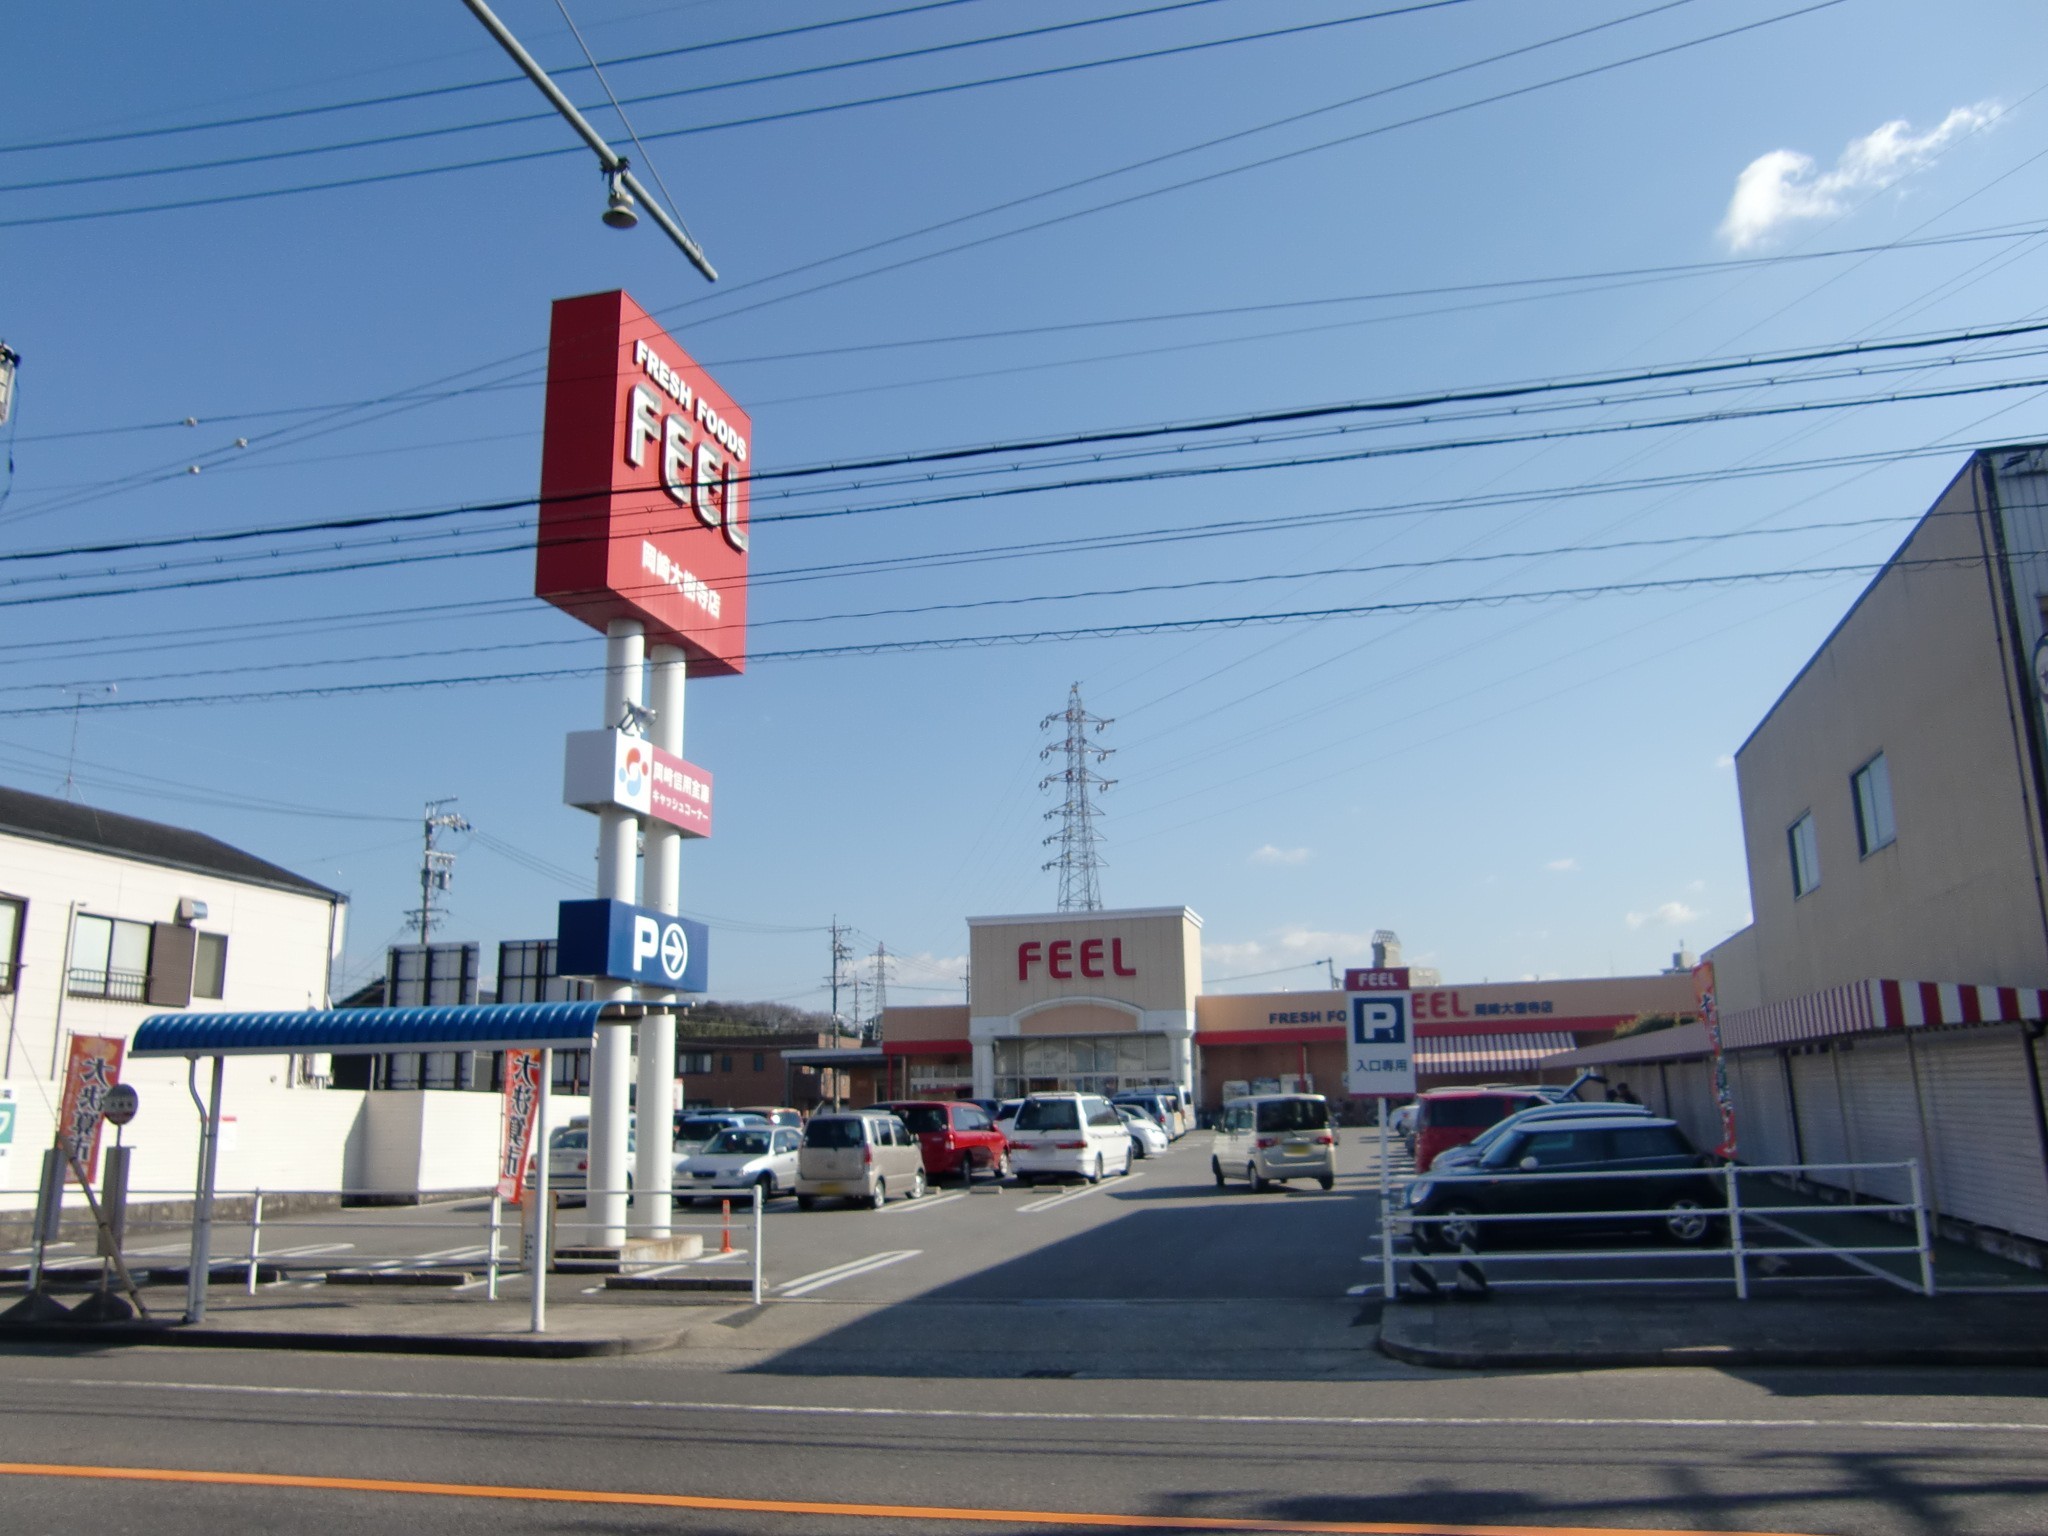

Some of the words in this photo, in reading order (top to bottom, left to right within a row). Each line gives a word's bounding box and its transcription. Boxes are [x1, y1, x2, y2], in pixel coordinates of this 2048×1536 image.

[634, 340, 692, 412] FRESH
[694, 397, 747, 462] FOODS
[624, 383, 750, 555] FEEL
[652, 789, 709, 820] キャッシュコーナー
[633, 915, 659, 971] P
[1018, 938, 1136, 980] FEEL
[1358, 973, 1398, 987] FEEL
[1269, 1010, 1321, 1024] FRESH
[1363, 1003, 1397, 1039] P
[1411, 992, 1469, 1019] EEL
[1357, 1060, 1407, 1072] 入口専用
